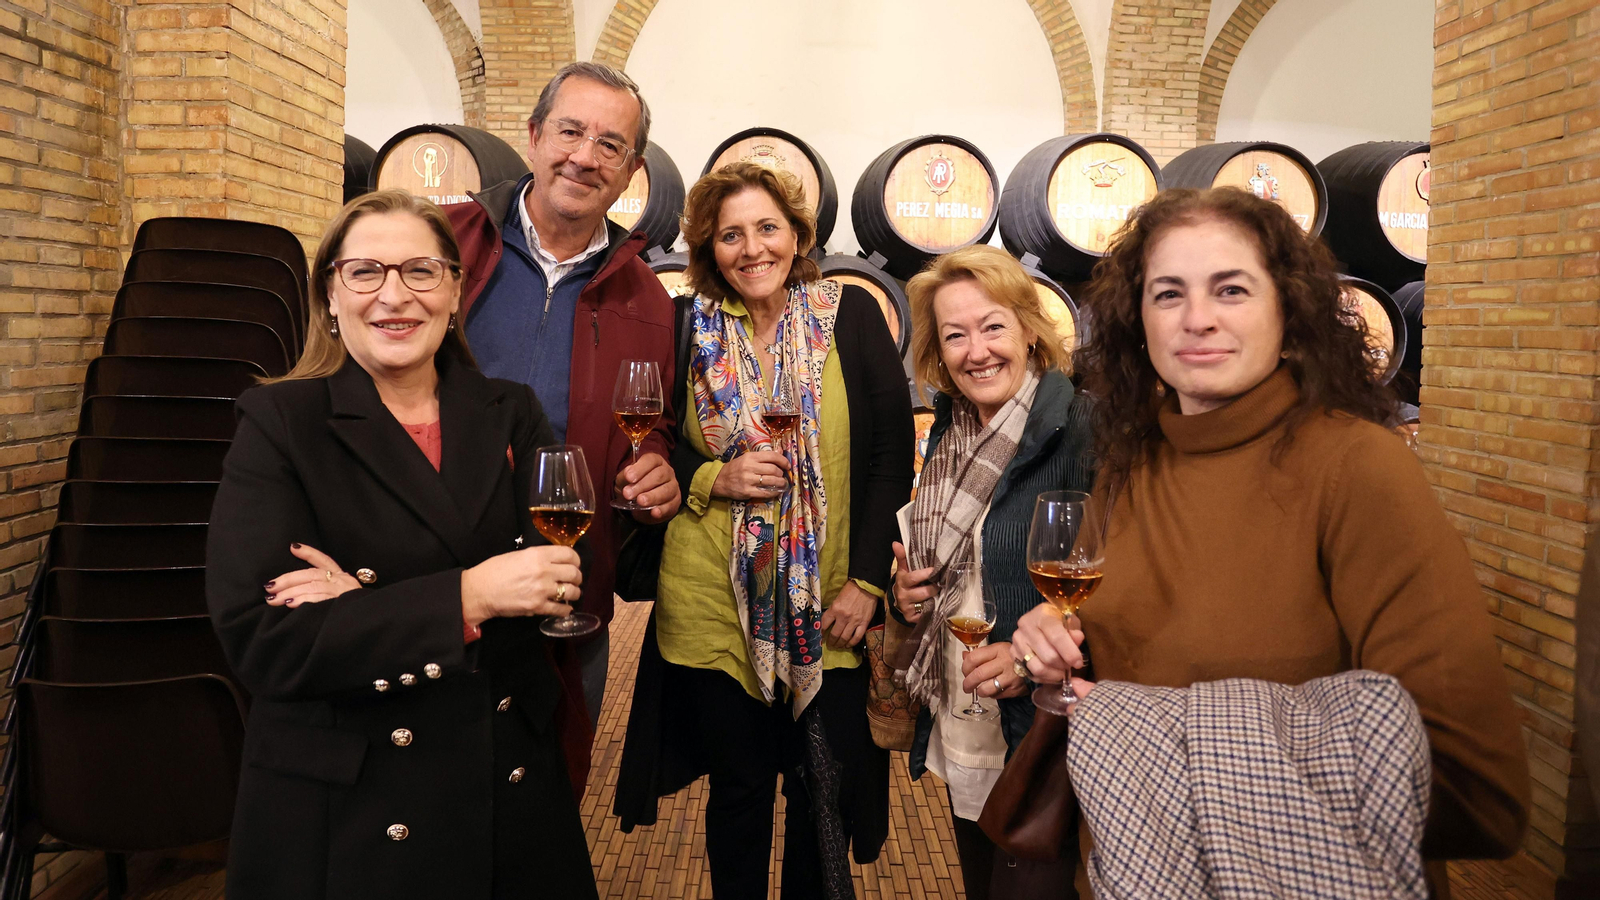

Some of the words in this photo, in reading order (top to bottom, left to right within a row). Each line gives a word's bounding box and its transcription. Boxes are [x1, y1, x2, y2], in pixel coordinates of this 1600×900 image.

[896, 201, 930, 217] PEREZ
[935, 202, 969, 219] MEGIA
[971, 206, 983, 219] SA
[1390, 211, 1428, 230] GARCIA
